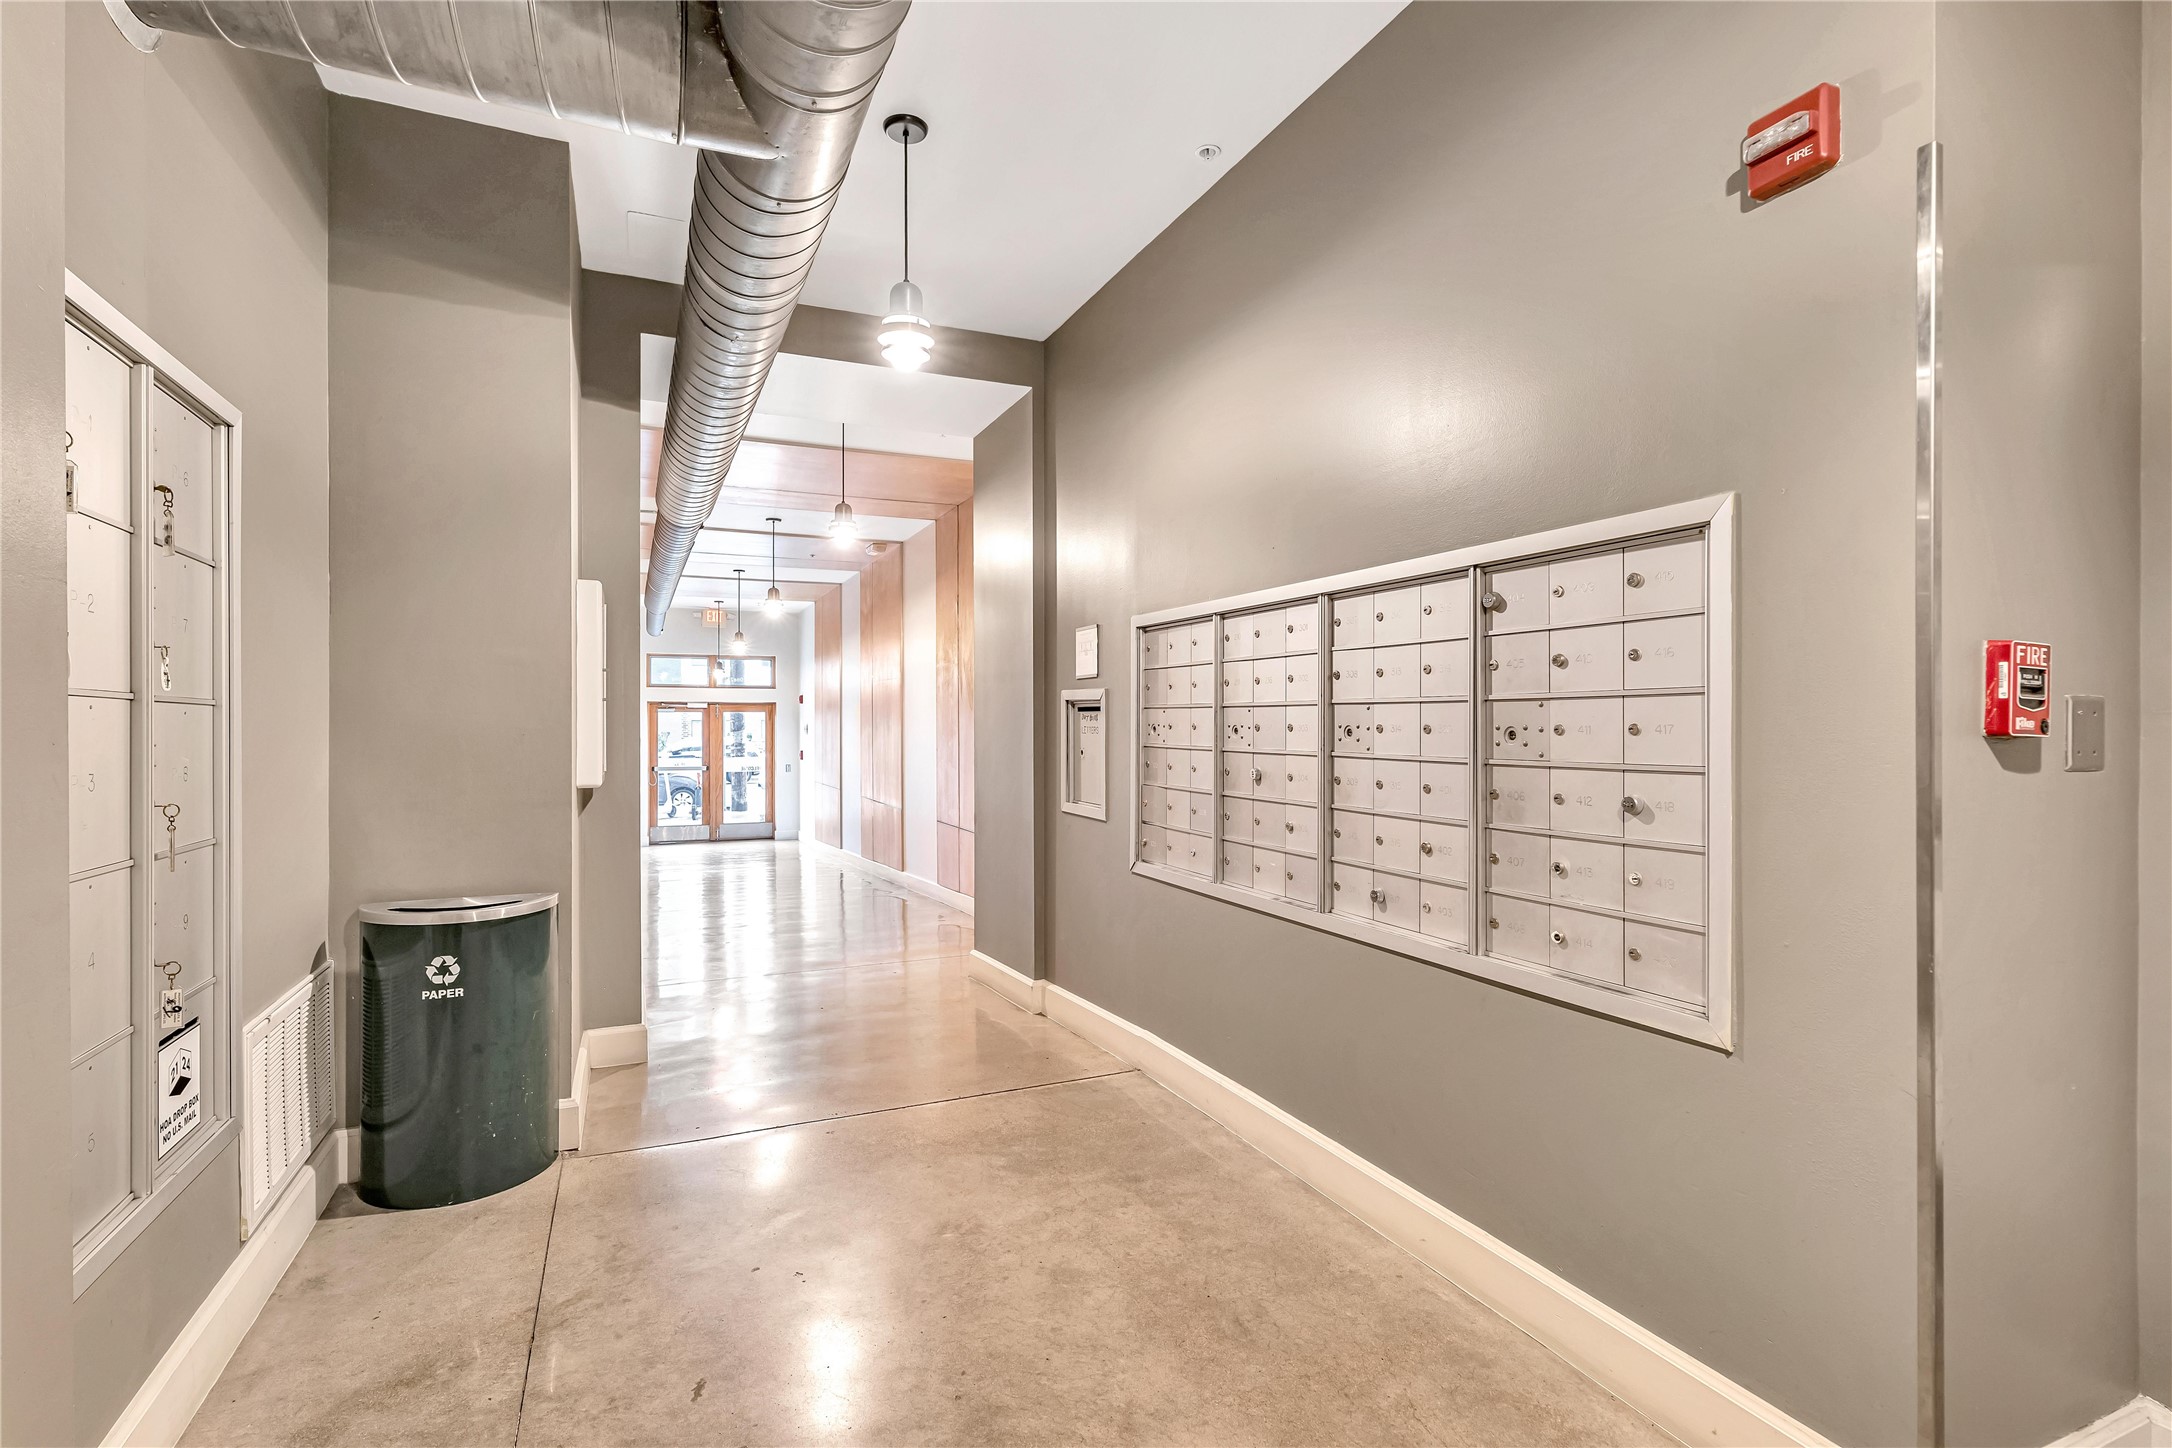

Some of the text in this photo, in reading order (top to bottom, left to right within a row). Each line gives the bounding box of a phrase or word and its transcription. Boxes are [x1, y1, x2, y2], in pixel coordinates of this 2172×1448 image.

[1786, 144, 1814, 165] FIRE
[1655, 570, 1675, 582] 415
[1654, 646, 1675, 658] 416
[2016, 645, 2048, 666] FIRE
[1346, 669, 1359, 679] 308
[1390, 667, 1402, 676] 313
[1390, 724, 1402, 733] 314
[1577, 725, 1592, 735] 411
[1654, 724, 1675, 735] 417
[1346, 777, 1359, 787] 309
[1507, 791, 1525, 802] 406
[1576, 796, 1593, 807] 412
[1655, 801, 1675, 813] 418
[1438, 845, 1453, 857] 402
[1507, 856, 1525, 867] 407
[1576, 867, 1593, 878] 413
[1655, 877, 1675, 890] 419
[1437, 906, 1453, 918] 403
[182, 914, 189, 931] 9
[1575, 936, 1593, 948] 414
[421, 988, 464, 1000] PAPER
[171, 1056, 191, 1082] 21 24
[160, 1094, 199, 1133] HOA DROP BOX
[162, 1109, 197, 1145] NO U.S. MAIL
[87, 1132, 96, 1152] 5
